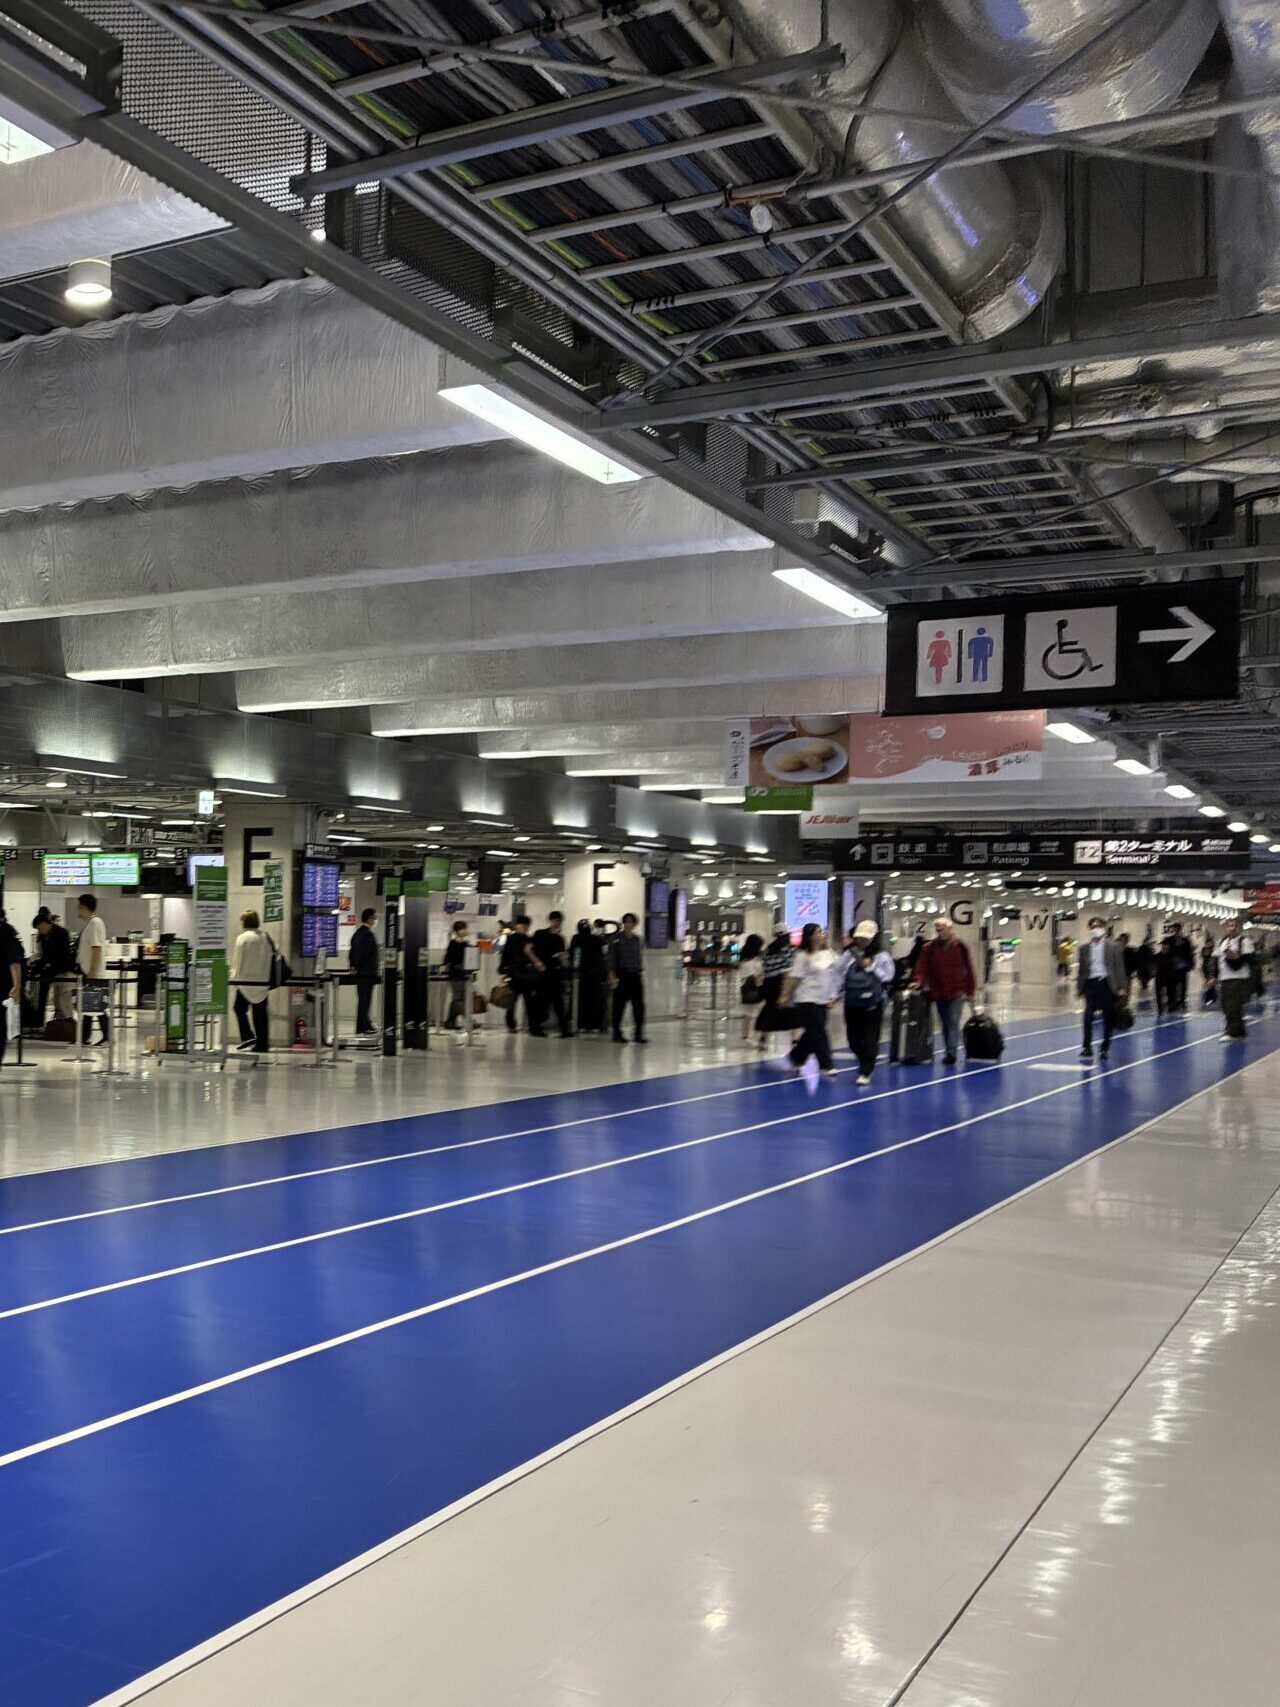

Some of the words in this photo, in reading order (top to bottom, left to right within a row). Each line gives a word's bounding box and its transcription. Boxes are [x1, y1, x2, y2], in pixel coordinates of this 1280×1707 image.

[243, 828, 273, 886] E
[1151, 854, 1160, 864] 2
[592, 863, 616, 905] F
[950, 900, 974, 926] G
